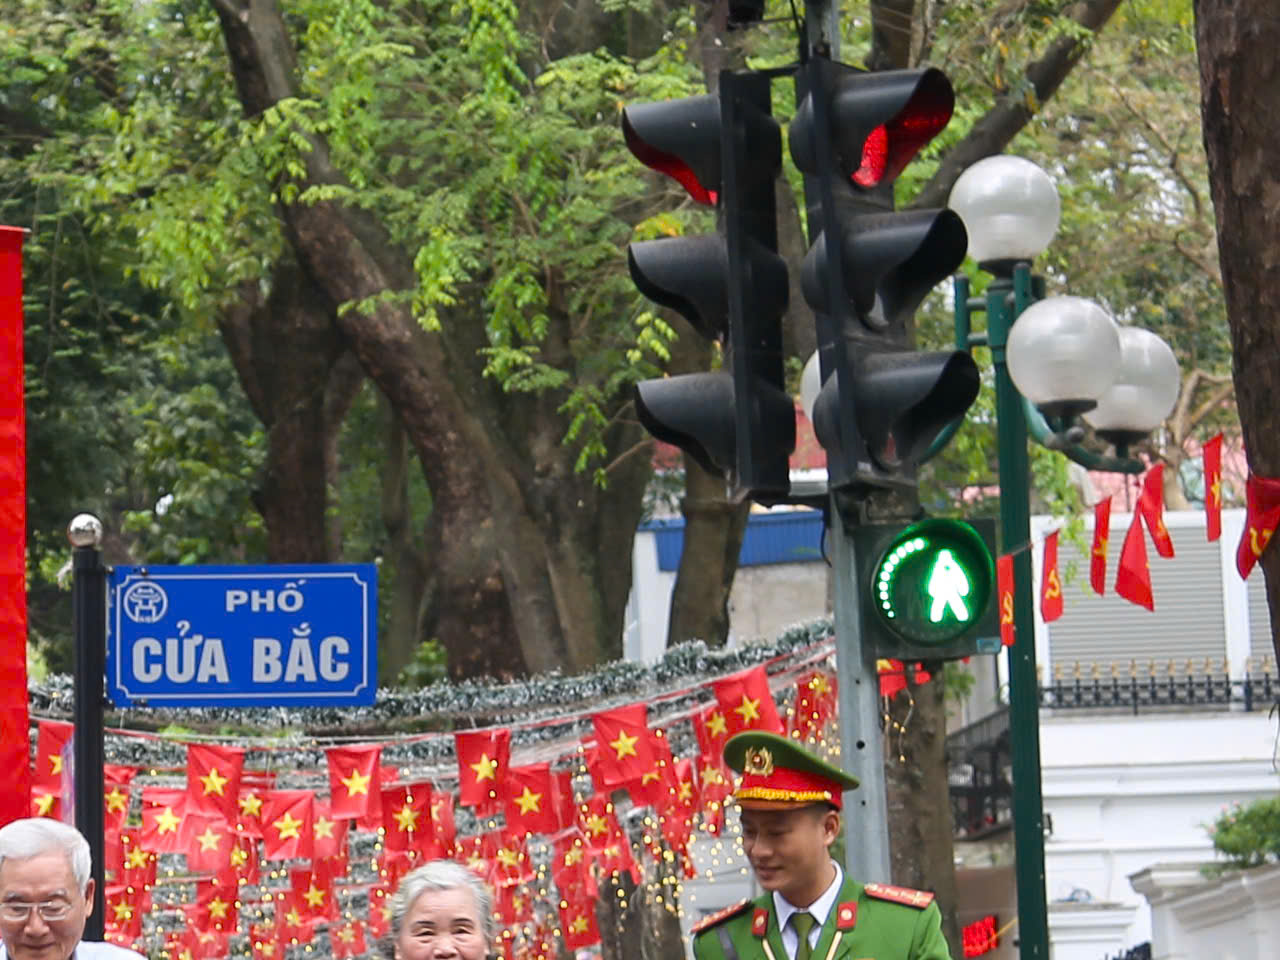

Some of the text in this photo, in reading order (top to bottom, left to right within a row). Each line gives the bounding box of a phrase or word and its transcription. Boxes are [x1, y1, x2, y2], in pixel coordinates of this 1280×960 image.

[226, 579, 306, 612] PHỐ
[132, 620, 350, 683] CỬA BẮC
